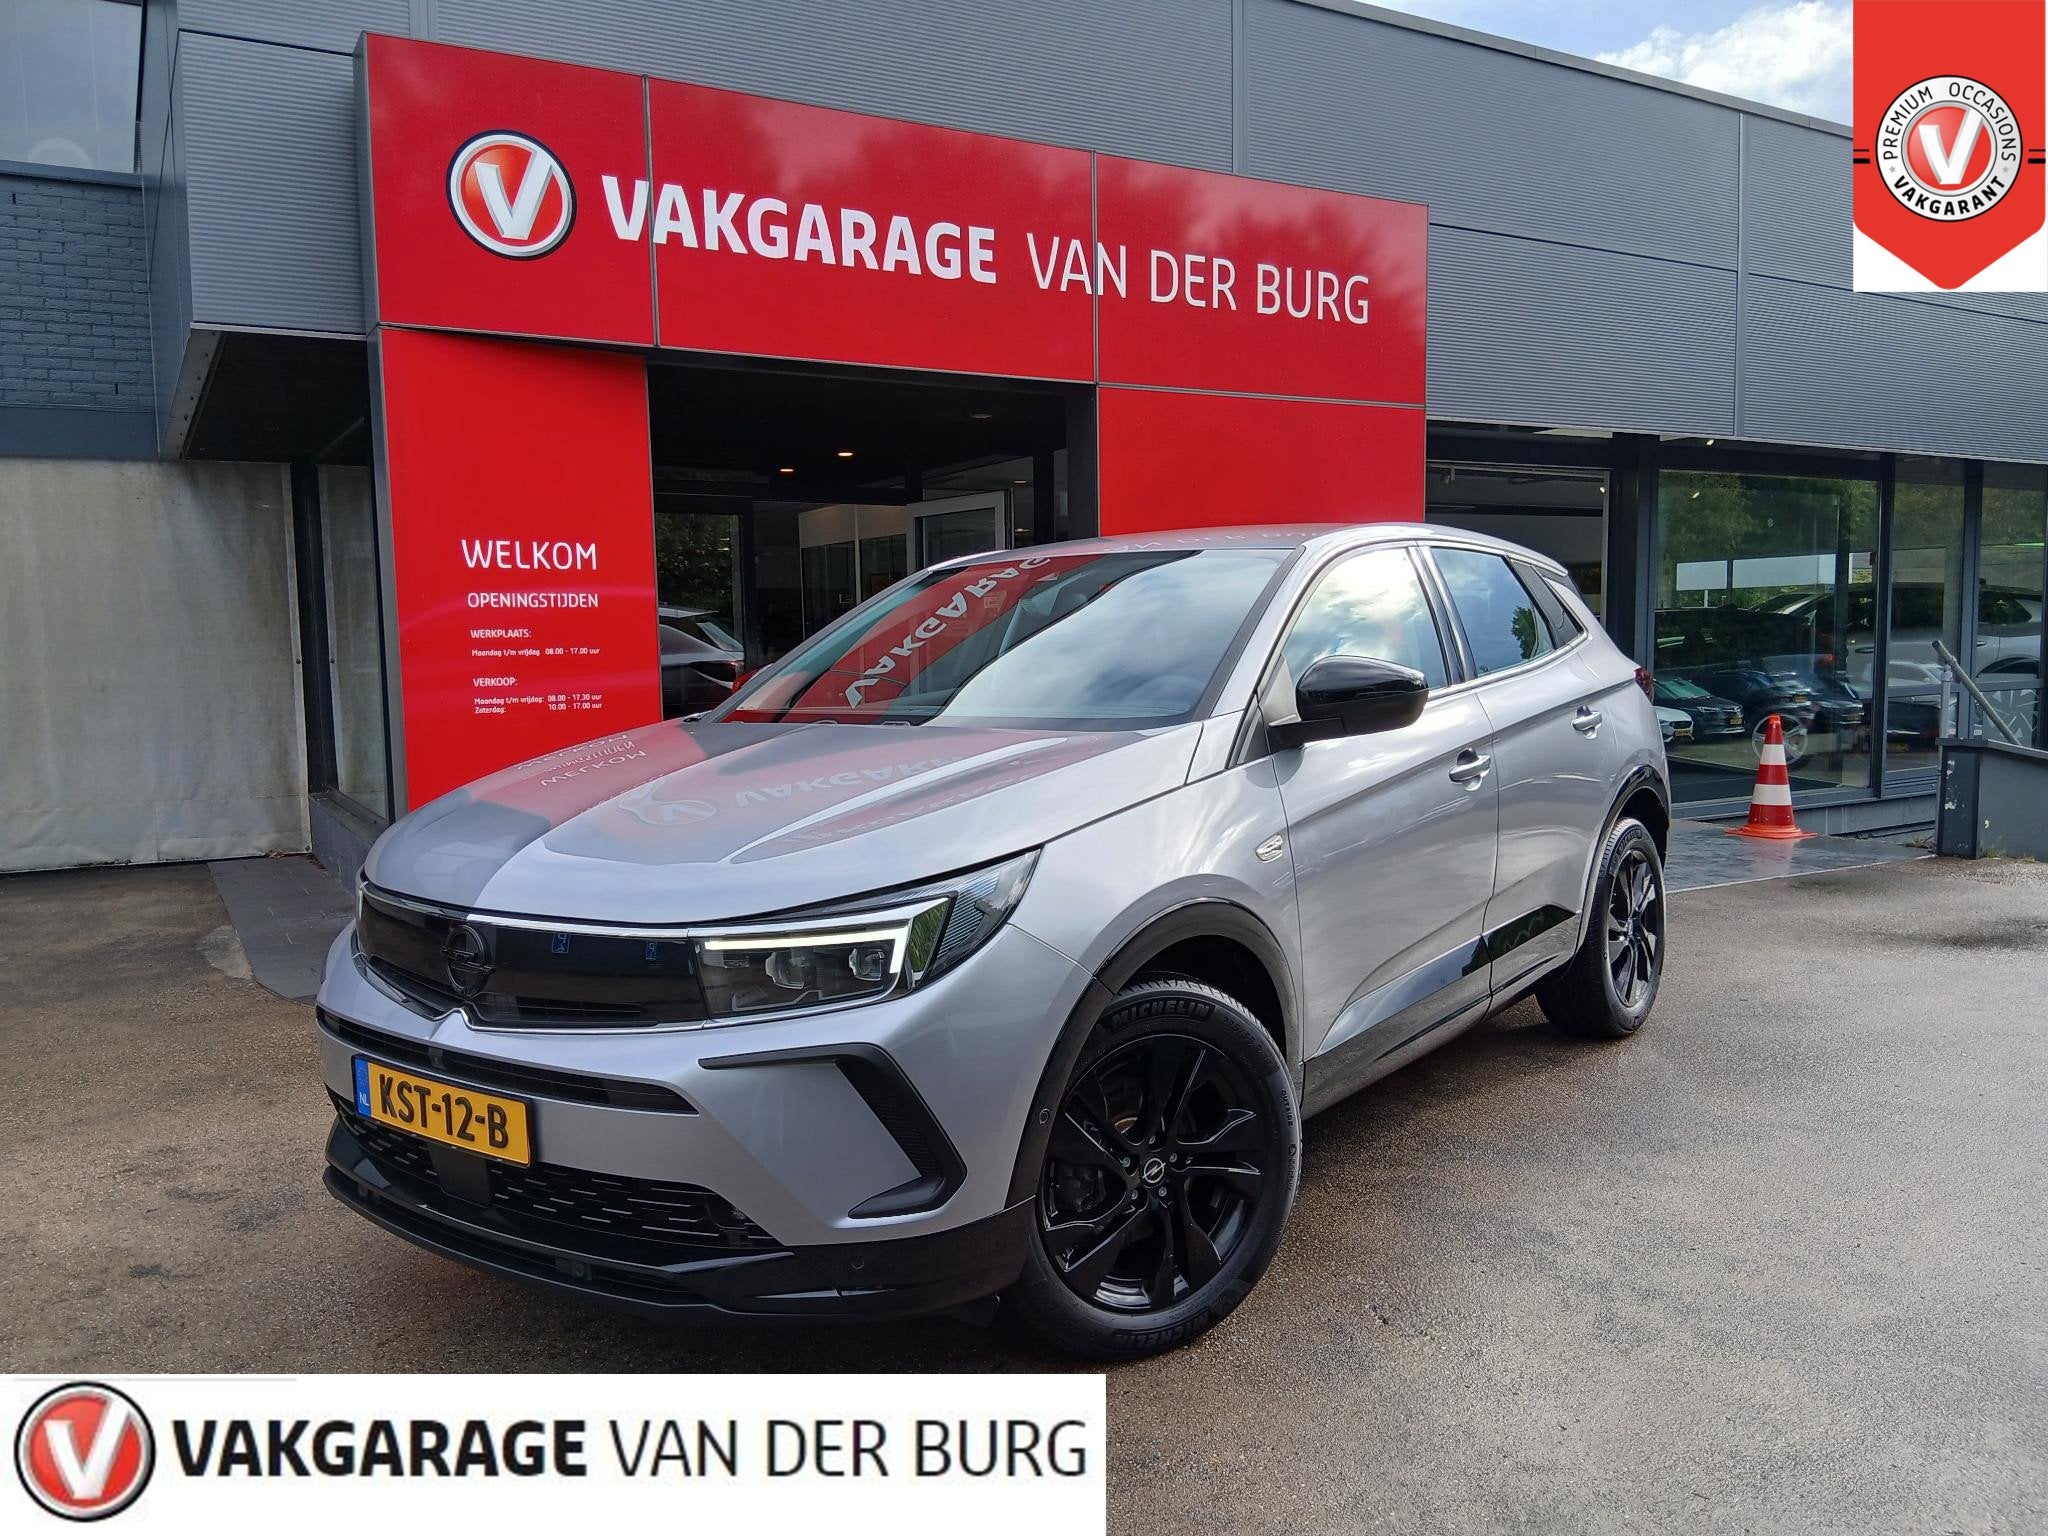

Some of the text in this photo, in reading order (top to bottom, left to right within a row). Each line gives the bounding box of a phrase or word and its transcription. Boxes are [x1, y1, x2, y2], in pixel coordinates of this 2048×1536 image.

[601, 174, 1370, 325] VAKGARAGE VAN DER BURG
[461, 539, 598, 570] WELKOM
[467, 592, 599, 608] OPENINGSTIJDEN
[470, 629, 532, 639] WERKPLAATS:
[472, 649, 502, 657] Maandag
[503, 648, 517, 656] t/m
[545, 647, 564, 655] 08.00
[570, 647, 588, 655] 17.00
[473, 677, 518, 687] VERKOOP:
[474, 697, 504, 705] Maandag
[1111, 1000, 1211, 1028] MICHELIN
[359, 1092, 369, 1107] NL
[379, 1073, 509, 1149] KST-12-B
